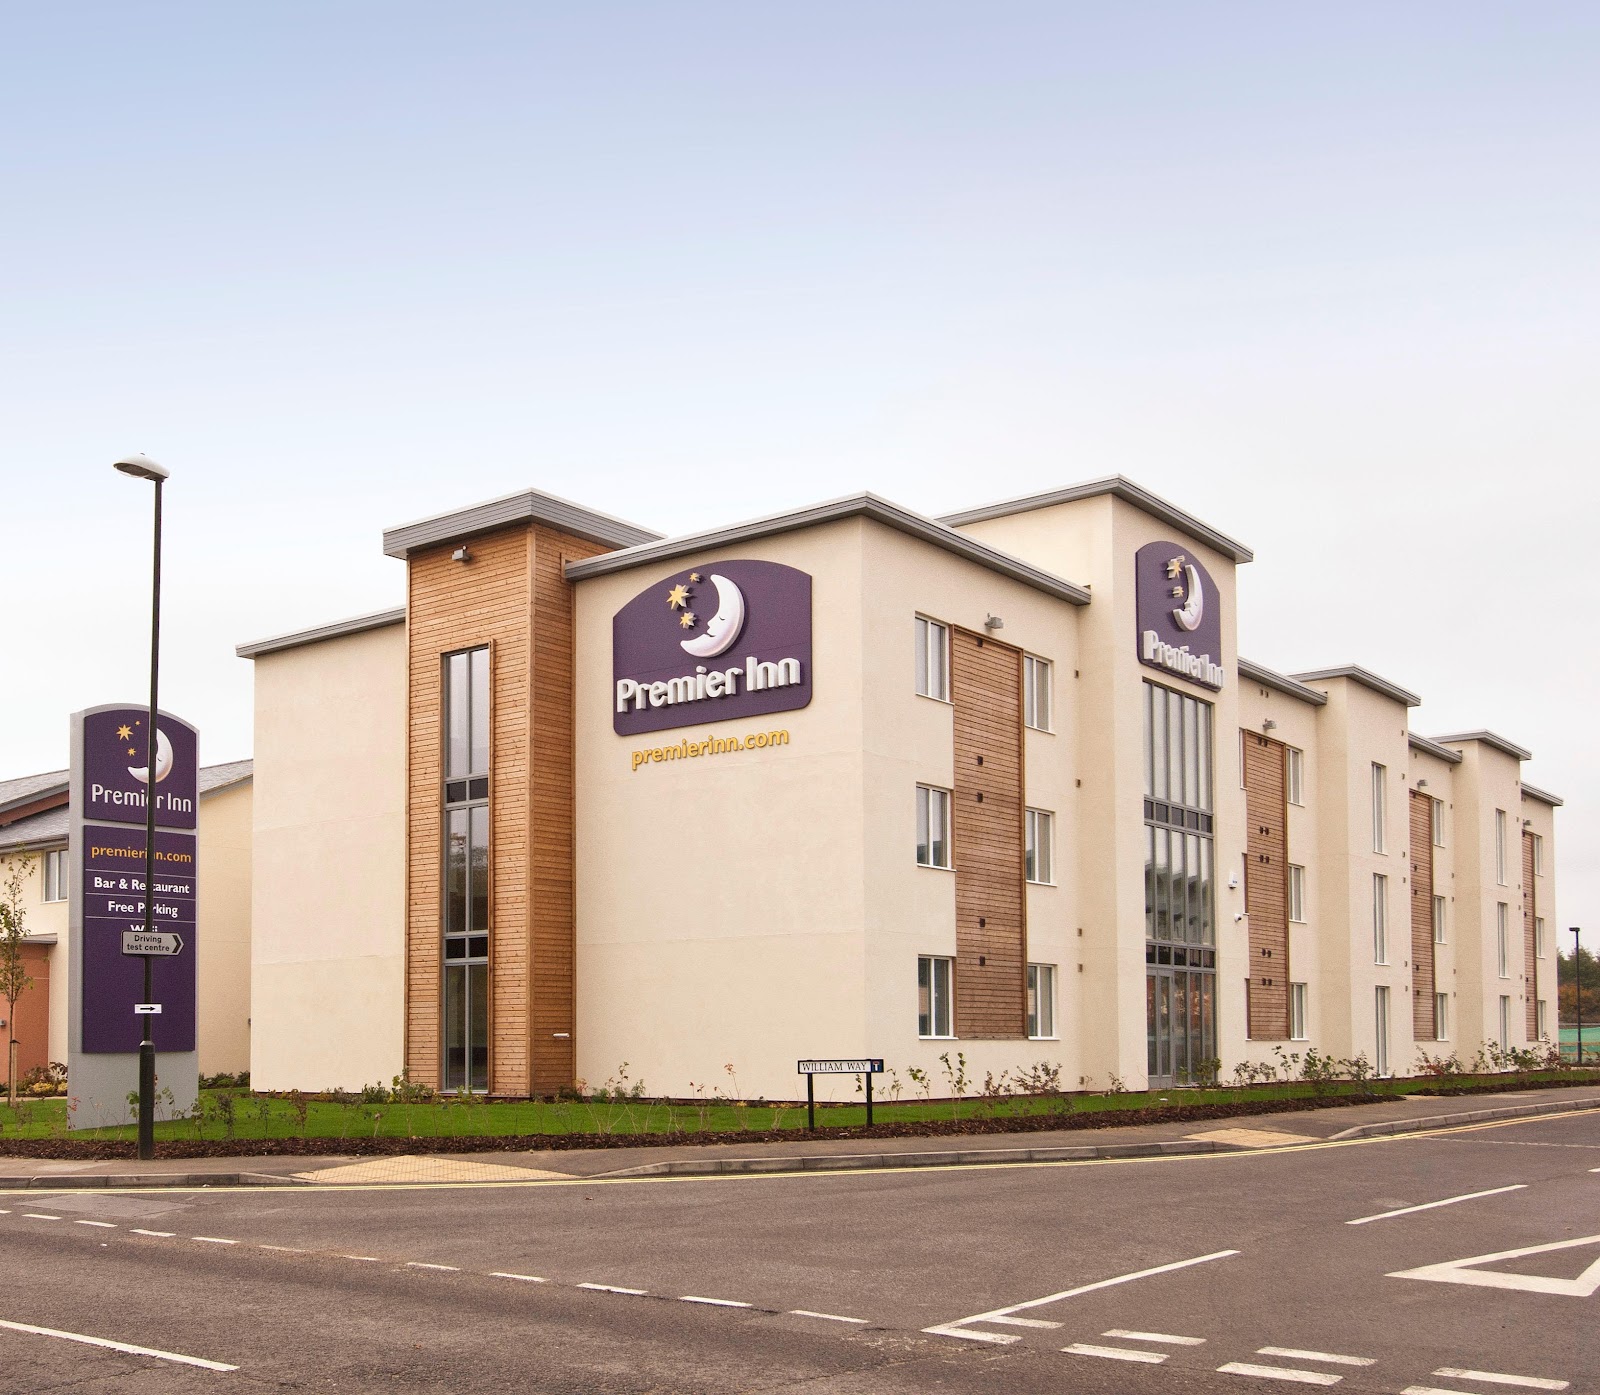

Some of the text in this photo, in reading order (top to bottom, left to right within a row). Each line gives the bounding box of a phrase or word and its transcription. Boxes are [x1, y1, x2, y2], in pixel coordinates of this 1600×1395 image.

[1143, 630, 1224, 688] Premier Inn
[616, 656, 800, 713] Premier Inn
[632, 729, 789, 771] premierinn.com
[91, 783, 192, 813] Premir Inn
[91, 846, 192, 863] premierin.com
[94, 876, 190, 894] Bar & Reaurant
[108, 900, 134, 913] Free
[134, 934, 162, 943] Driving
[127, 943, 170, 952] test centre
[802, 1061, 867, 1072] WILLIAM WAY
